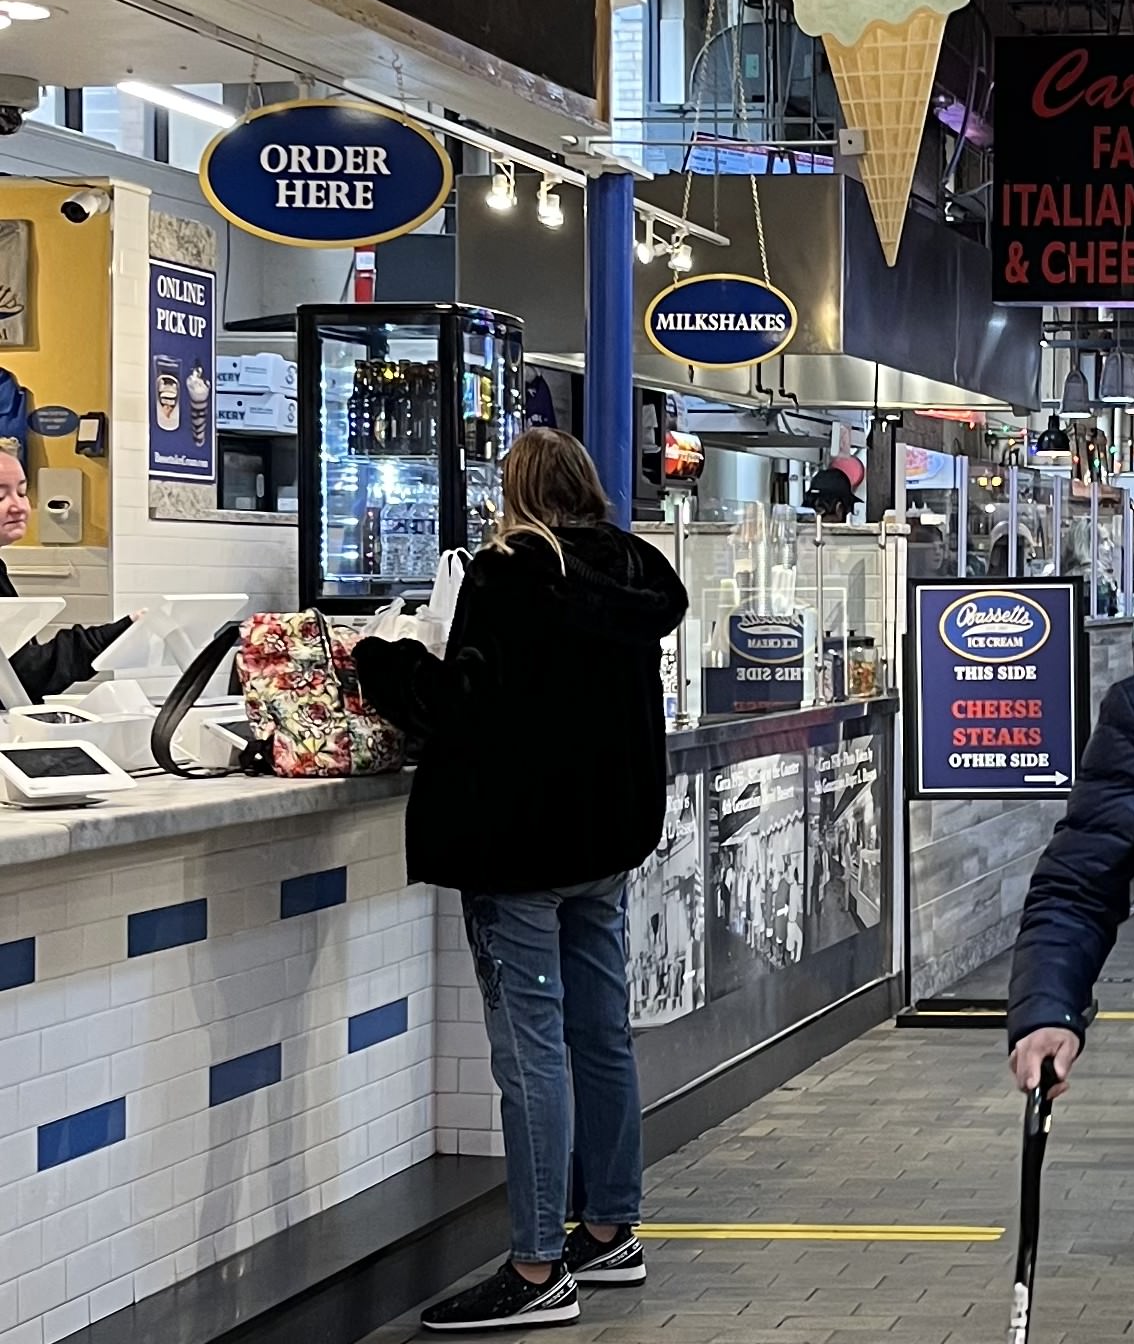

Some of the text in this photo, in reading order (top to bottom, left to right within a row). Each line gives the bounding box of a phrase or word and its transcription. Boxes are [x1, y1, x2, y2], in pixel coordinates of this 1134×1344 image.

[259, 143, 392, 175] ORDER
[275, 179, 374, 210] HERE
[1004, 240, 1030, 284] &
[156, 274, 206, 306] ONLINE
[156, 307, 207, 338] PICK UP
[655, 312, 787, 332] MILKSHAKES
[956, 601, 1034, 630] Bassetts
[967, 636, 1024, 648] ICE CREAM
[953, 665, 1037, 681] THIS SIDE
[951, 699, 1043, 719] CHEESE
[952, 727, 1042, 747] STEAKS
[948, 753, 1050, 768] OTHER SIDE
